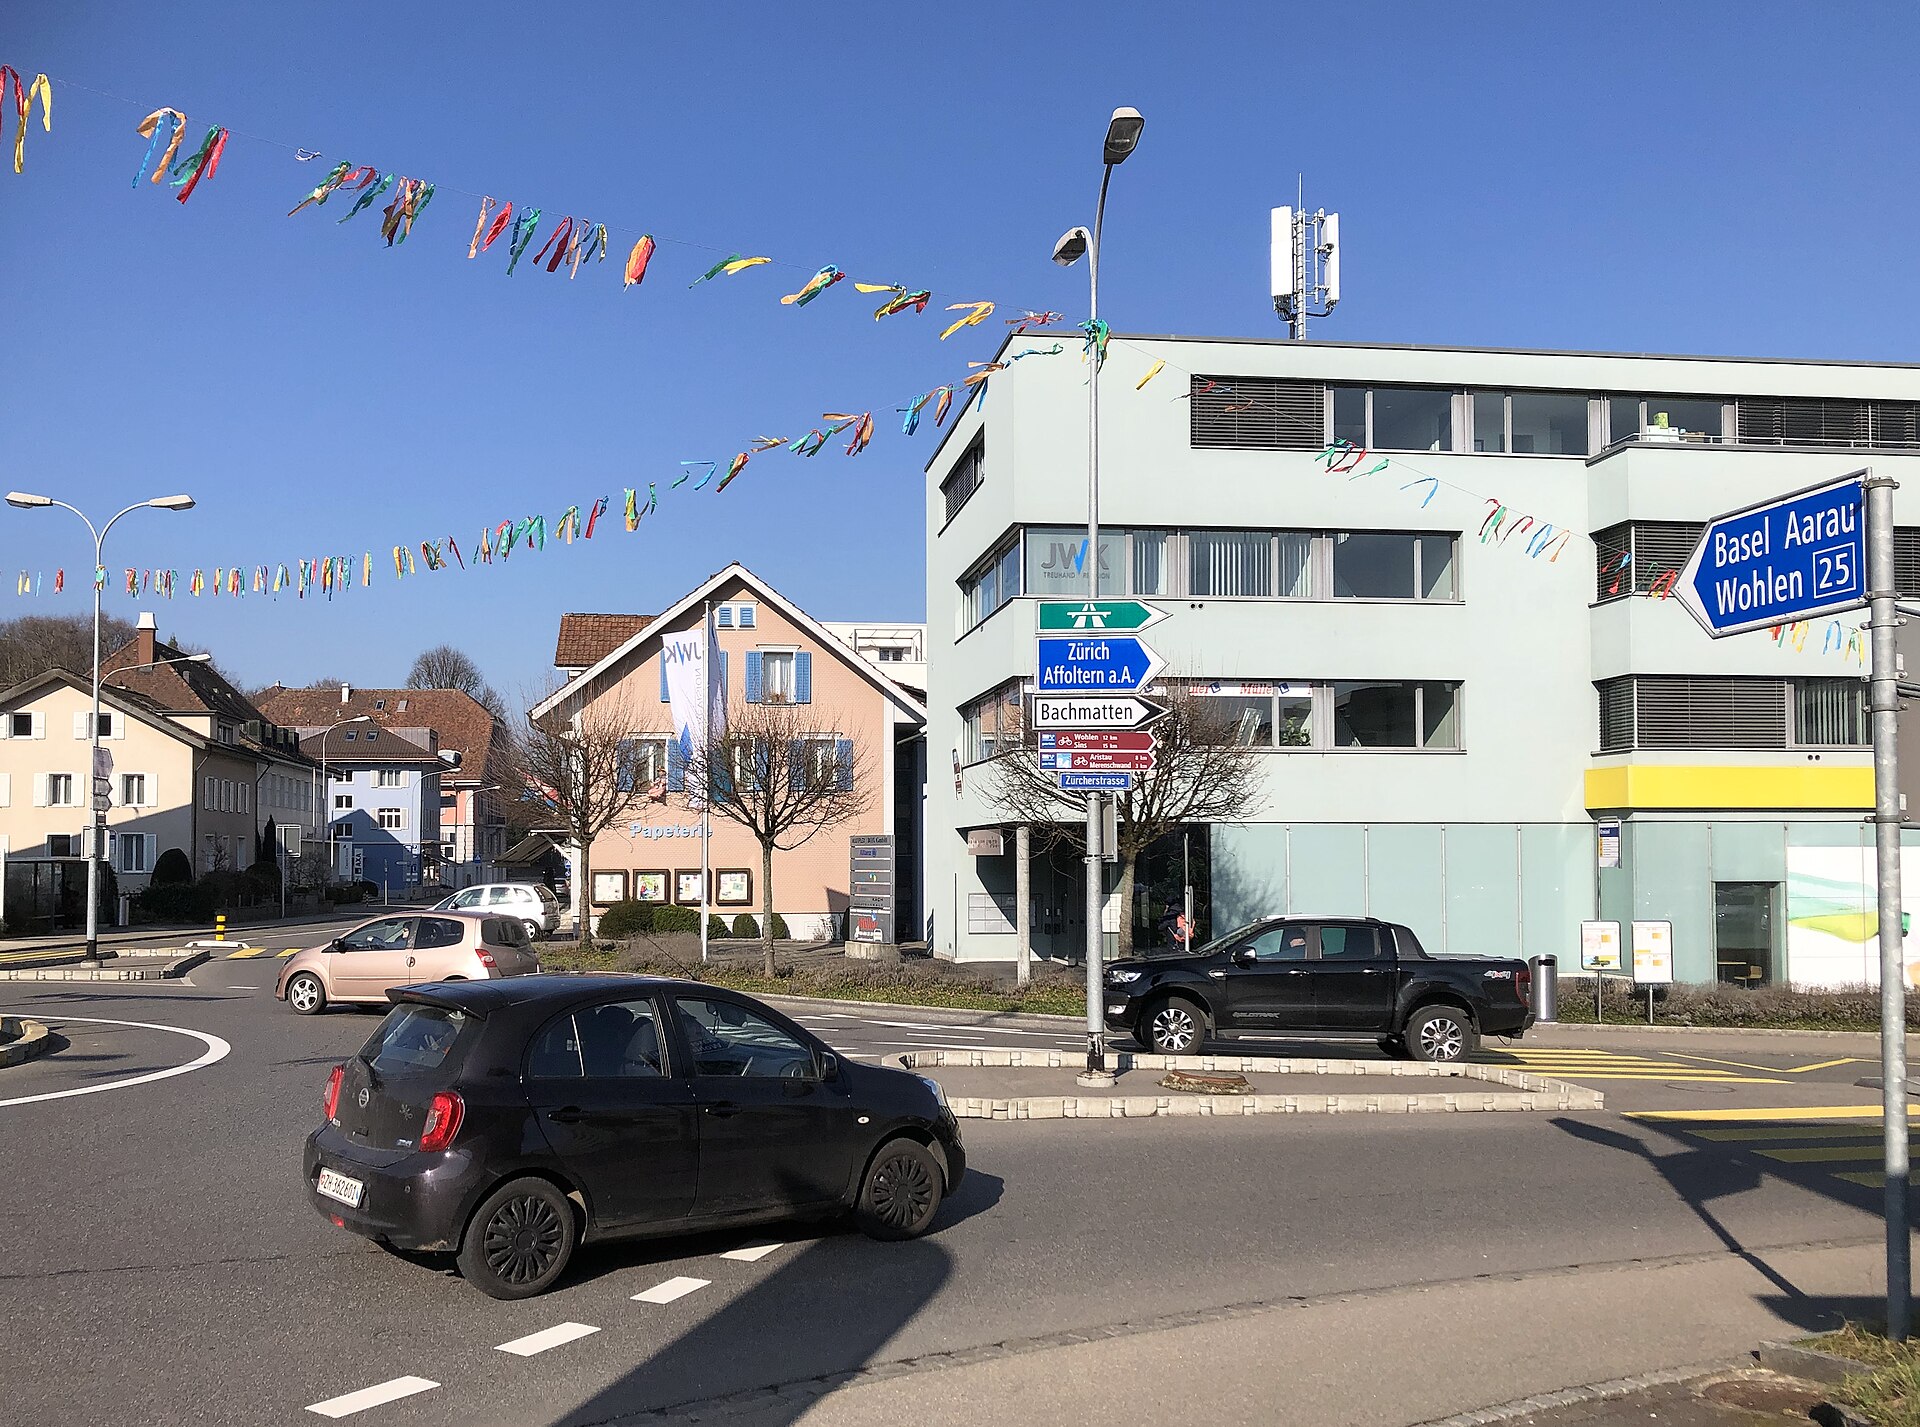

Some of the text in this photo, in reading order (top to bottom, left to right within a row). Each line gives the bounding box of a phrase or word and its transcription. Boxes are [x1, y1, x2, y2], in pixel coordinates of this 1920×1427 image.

[1715, 503, 1855, 568] Basel Aarau
[1716, 552, 1850, 616] Wohlen 25
[1067, 642, 1110, 661] Zürich
[1043, 665, 1135, 684] Affoltern a.A.
[1240, 683, 1274, 695] Mülle
[1041, 702, 1133, 721] Bachmatten
[1073, 741, 1087, 749] Sins
[1074, 733, 1099, 741] Wohlen
[1065, 775, 1125, 786] Zürcherstrasse
[323, 1174, 333, 1191] ZH
